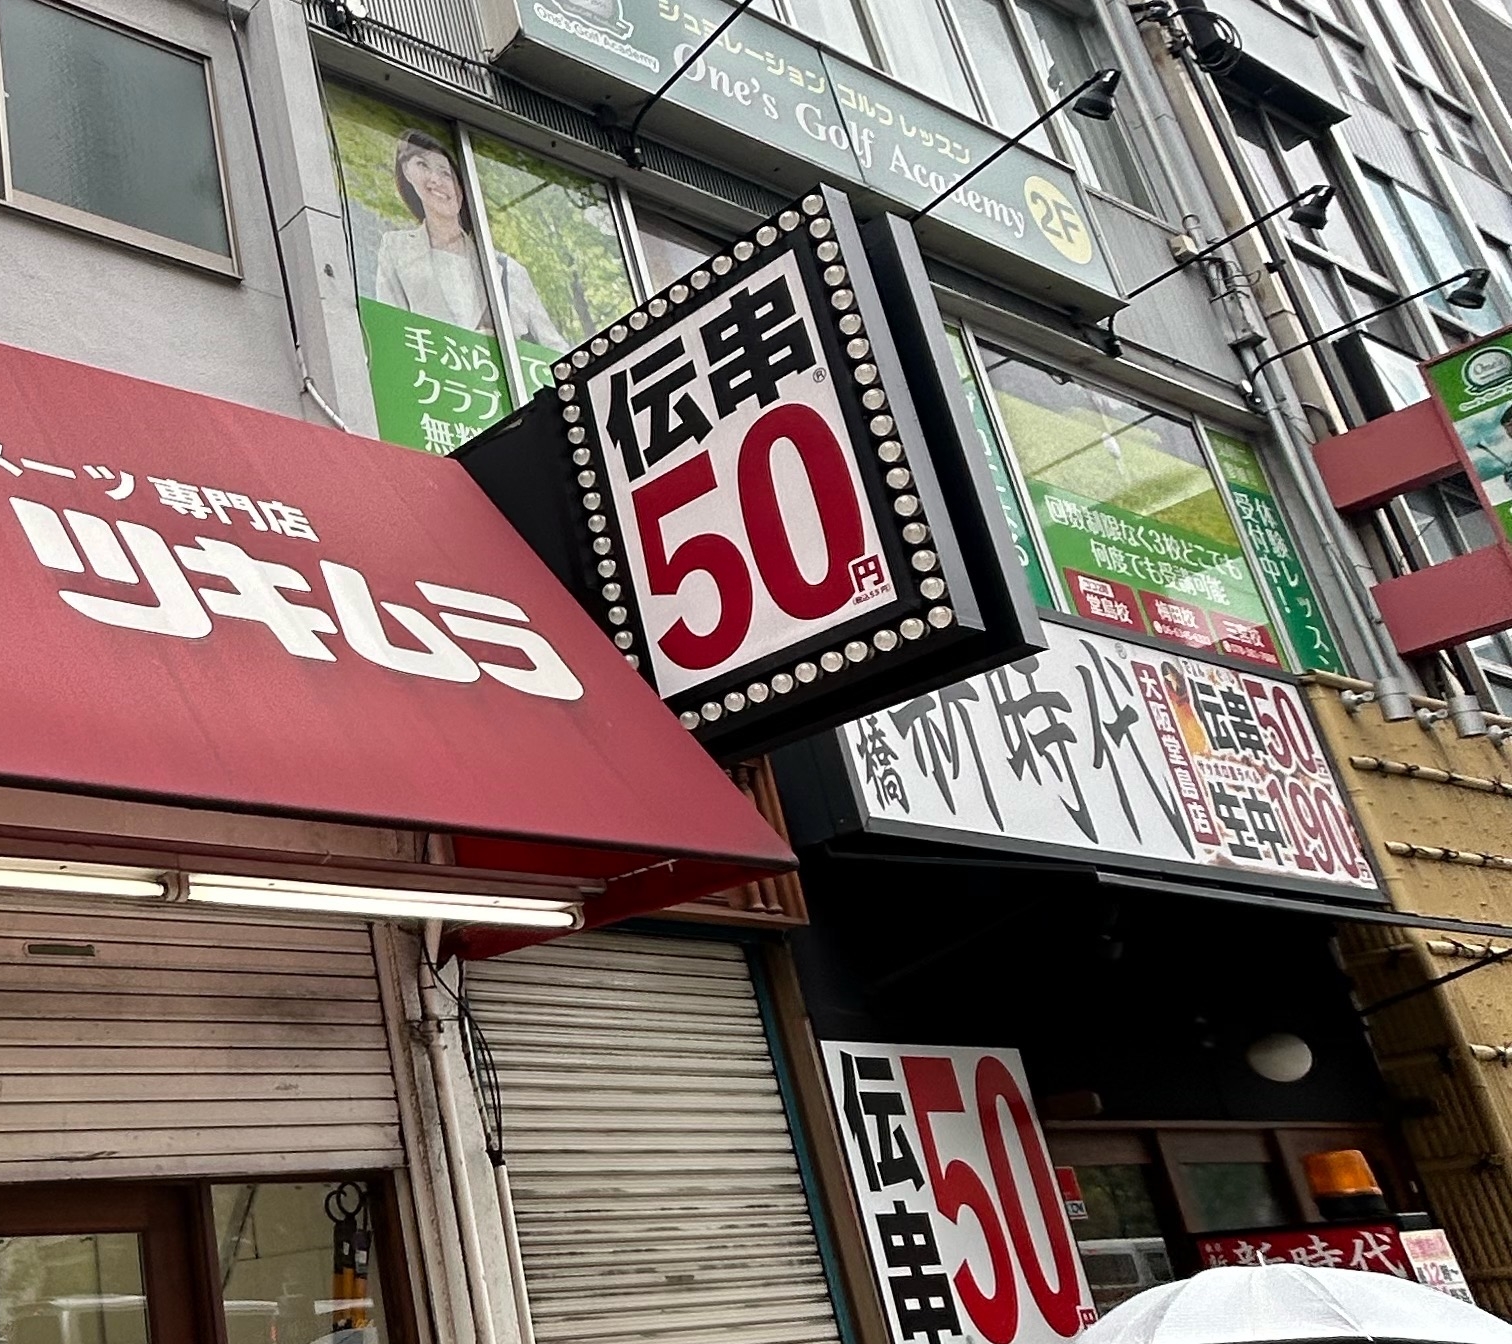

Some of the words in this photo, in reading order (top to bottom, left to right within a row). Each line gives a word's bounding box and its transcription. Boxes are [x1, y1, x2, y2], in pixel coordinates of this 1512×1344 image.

[674, 42, 779, 120] One's
[796, 102, 876, 168] Golf
[889, 145, 1026, 239] Academy
[1029, 191, 1083, 244] 2F
[413, 370, 501, 420] クラブ
[607, 274, 817, 483] 伝串
[149, 476, 320, 543] 専門店
[9, 495, 585, 701] ツキムラ
[1140, 669, 1213, 835] 大阪堂島店
[1188, 679, 1269, 760] 伝串
[1209, 781, 1288, 866] 生中
